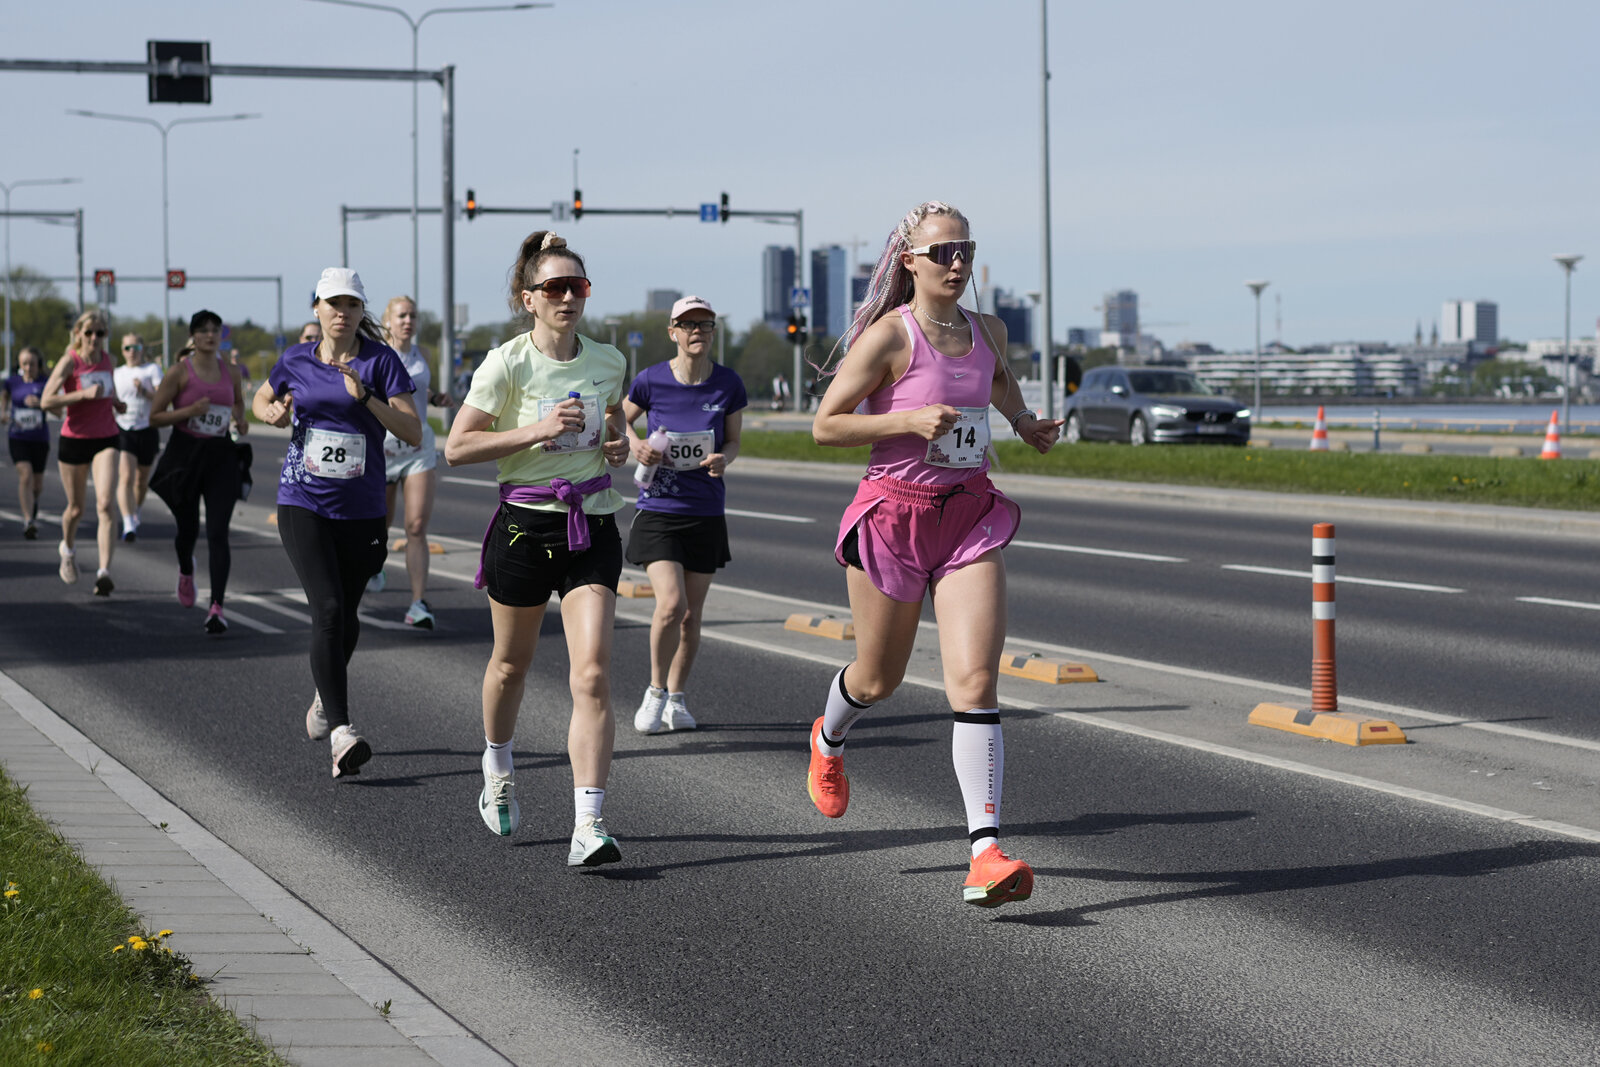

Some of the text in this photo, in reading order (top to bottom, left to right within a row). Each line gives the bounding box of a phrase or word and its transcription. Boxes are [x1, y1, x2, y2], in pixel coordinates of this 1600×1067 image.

[199, 413, 223, 427] 438
[952, 426, 976, 449] 14
[321, 445, 347, 464] 28
[670, 444, 704, 459] 506
